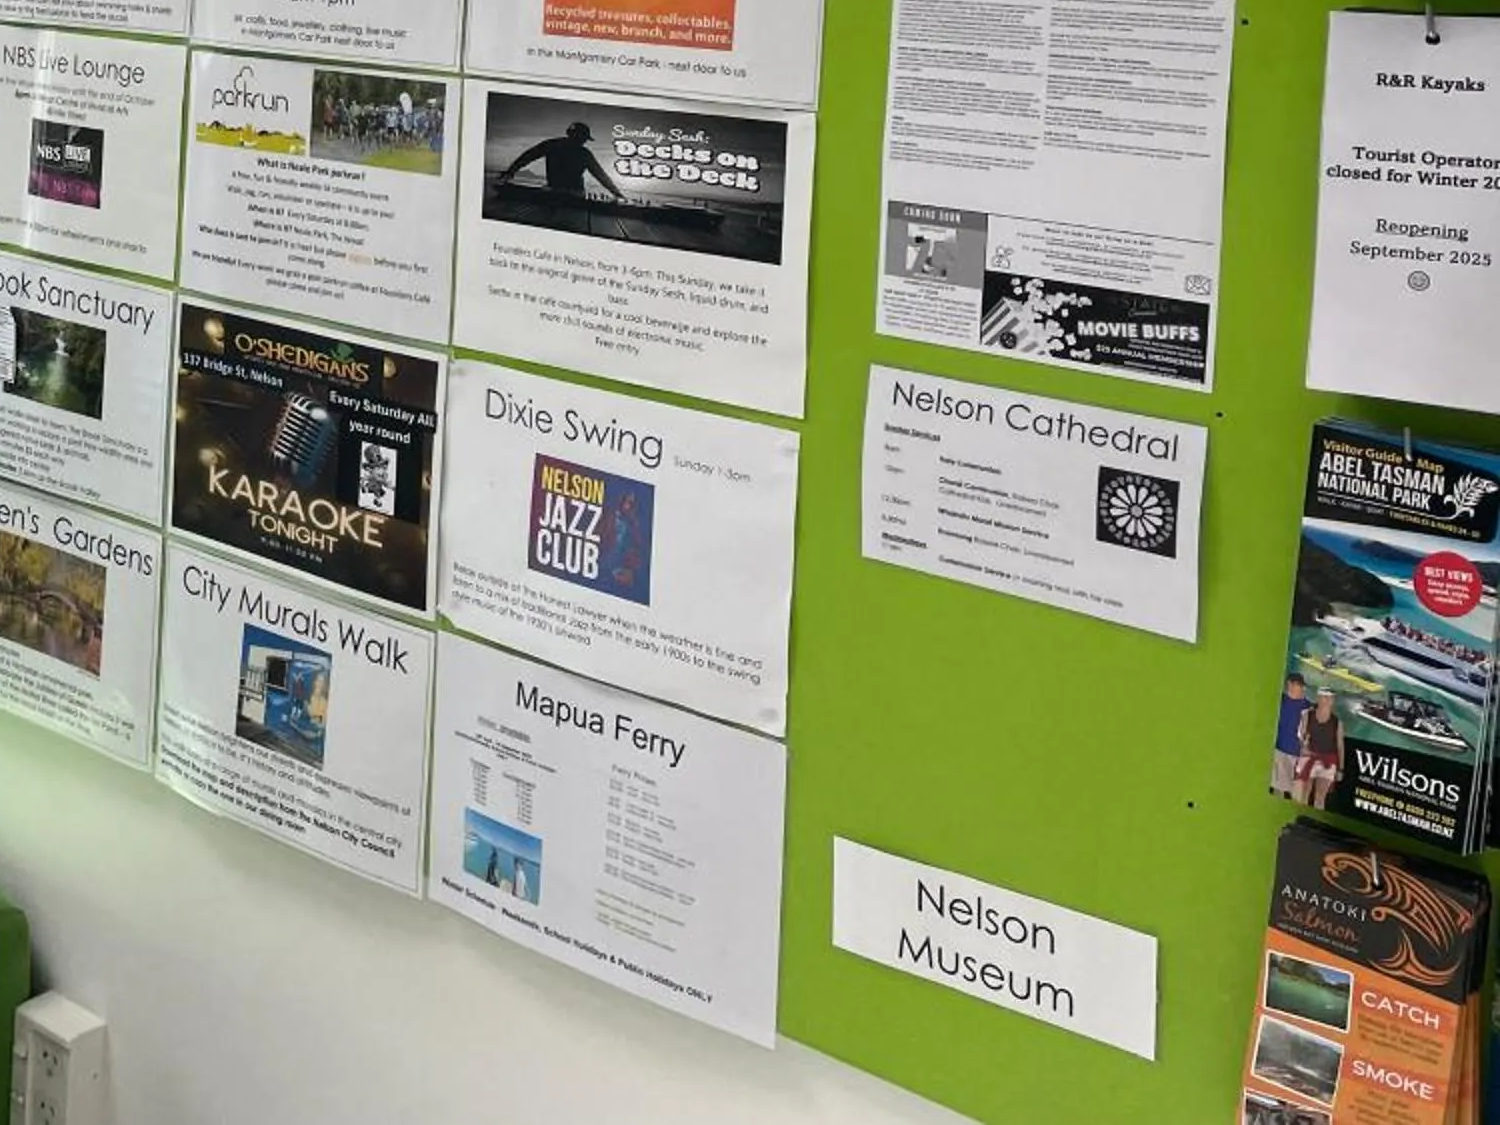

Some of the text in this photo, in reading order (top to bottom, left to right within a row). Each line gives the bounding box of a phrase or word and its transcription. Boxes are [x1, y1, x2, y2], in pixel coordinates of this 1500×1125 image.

[669, 30, 692, 40] and
[3, 45, 35, 68] NBS
[74, 54, 145, 87] Lounge
[1376, 73, 1486, 94] R&R Kayaks
[613, 139, 760, 171] Decks on
[614, 157, 760, 191] the Deck
[1326, 164, 1381, 182] closed
[1387, 168, 1412, 184] for
[1417, 170, 1478, 189] Winter
[1376, 218, 1469, 242] Reopening
[1350, 240, 1491, 267] September 2025
[37, 276, 155, 335] Sanctuary
[1077, 320, 1199, 341] MOVIE BUFFS
[235, 333, 370, 384] O'SHEDIGANS
[485, 387, 664, 469] Dixie Swing
[892, 380, 1179, 462] Nelson Cathedral
[541, 465, 605, 504] NELSON
[1317, 472, 1431, 510] NATIONAL PARK
[1319, 453, 1445, 495] ABEL TASMAN
[208, 465, 385, 547] KARAOKE
[539, 491, 602, 542] JAZZ
[53, 517, 153, 576] Gardens
[248, 509, 338, 554] TONIGHT
[535, 529, 600, 580] CLUB
[183, 565, 232, 613] City
[238, 587, 328, 643] Murals
[337, 618, 409, 674] Walk
[515, 681, 686, 768] Mapua Ferry
[1356, 749, 1460, 802] Wilsons
[916, 878, 1056, 955] Nelson
[1281, 884, 1366, 923] ANATOKI
[898, 927, 1074, 1017] Museum
[1361, 991, 1440, 1029] CATCH
[1352, 1059, 1435, 1100] SMOKE
